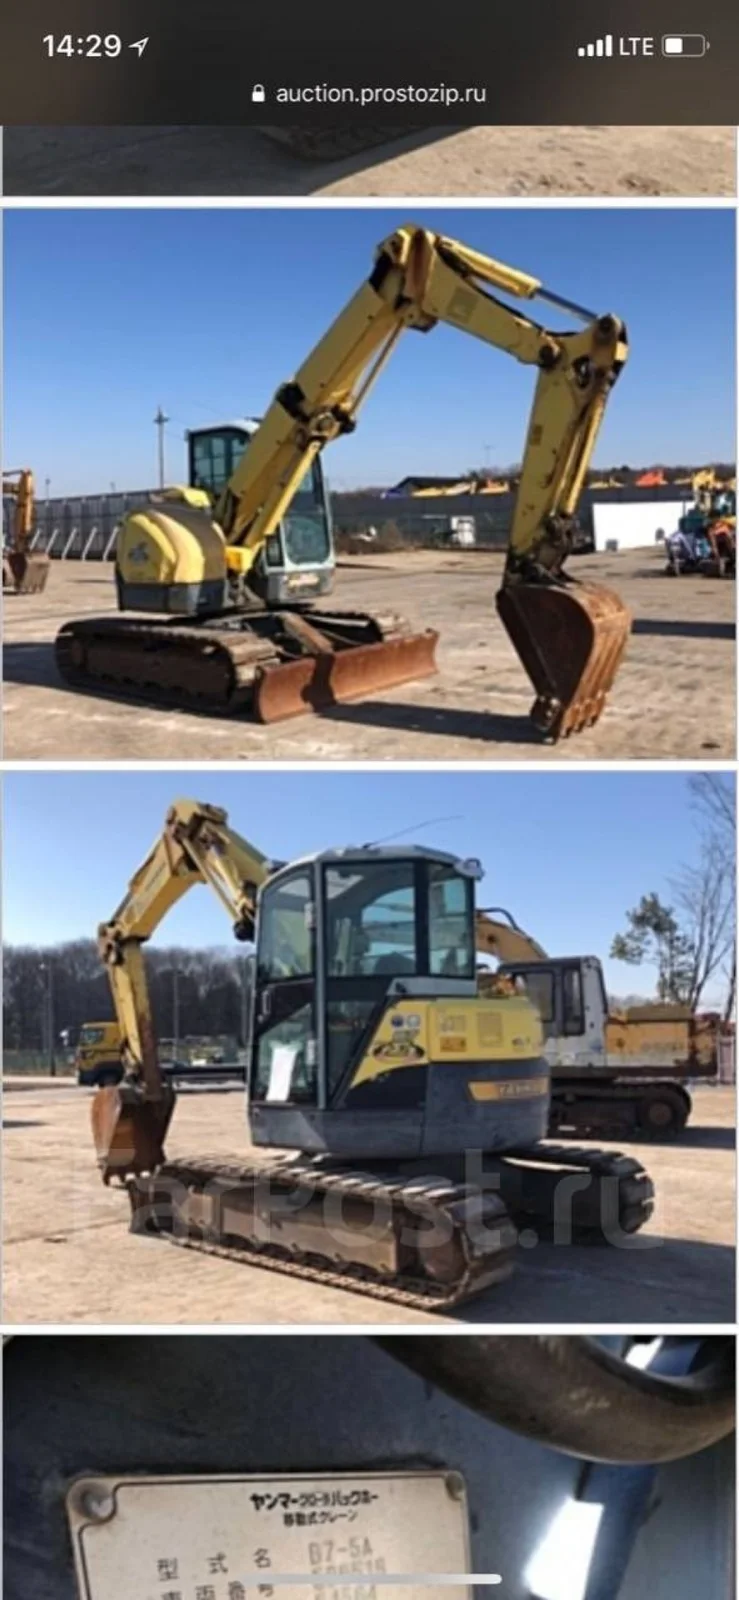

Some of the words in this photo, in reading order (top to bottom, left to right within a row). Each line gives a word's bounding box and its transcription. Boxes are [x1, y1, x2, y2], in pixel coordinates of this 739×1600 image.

[42, 34, 122, 58] 14:29
[618, 37, 655, 56] LTE
[275, 83, 487, 106] auction.prostozip.ru
